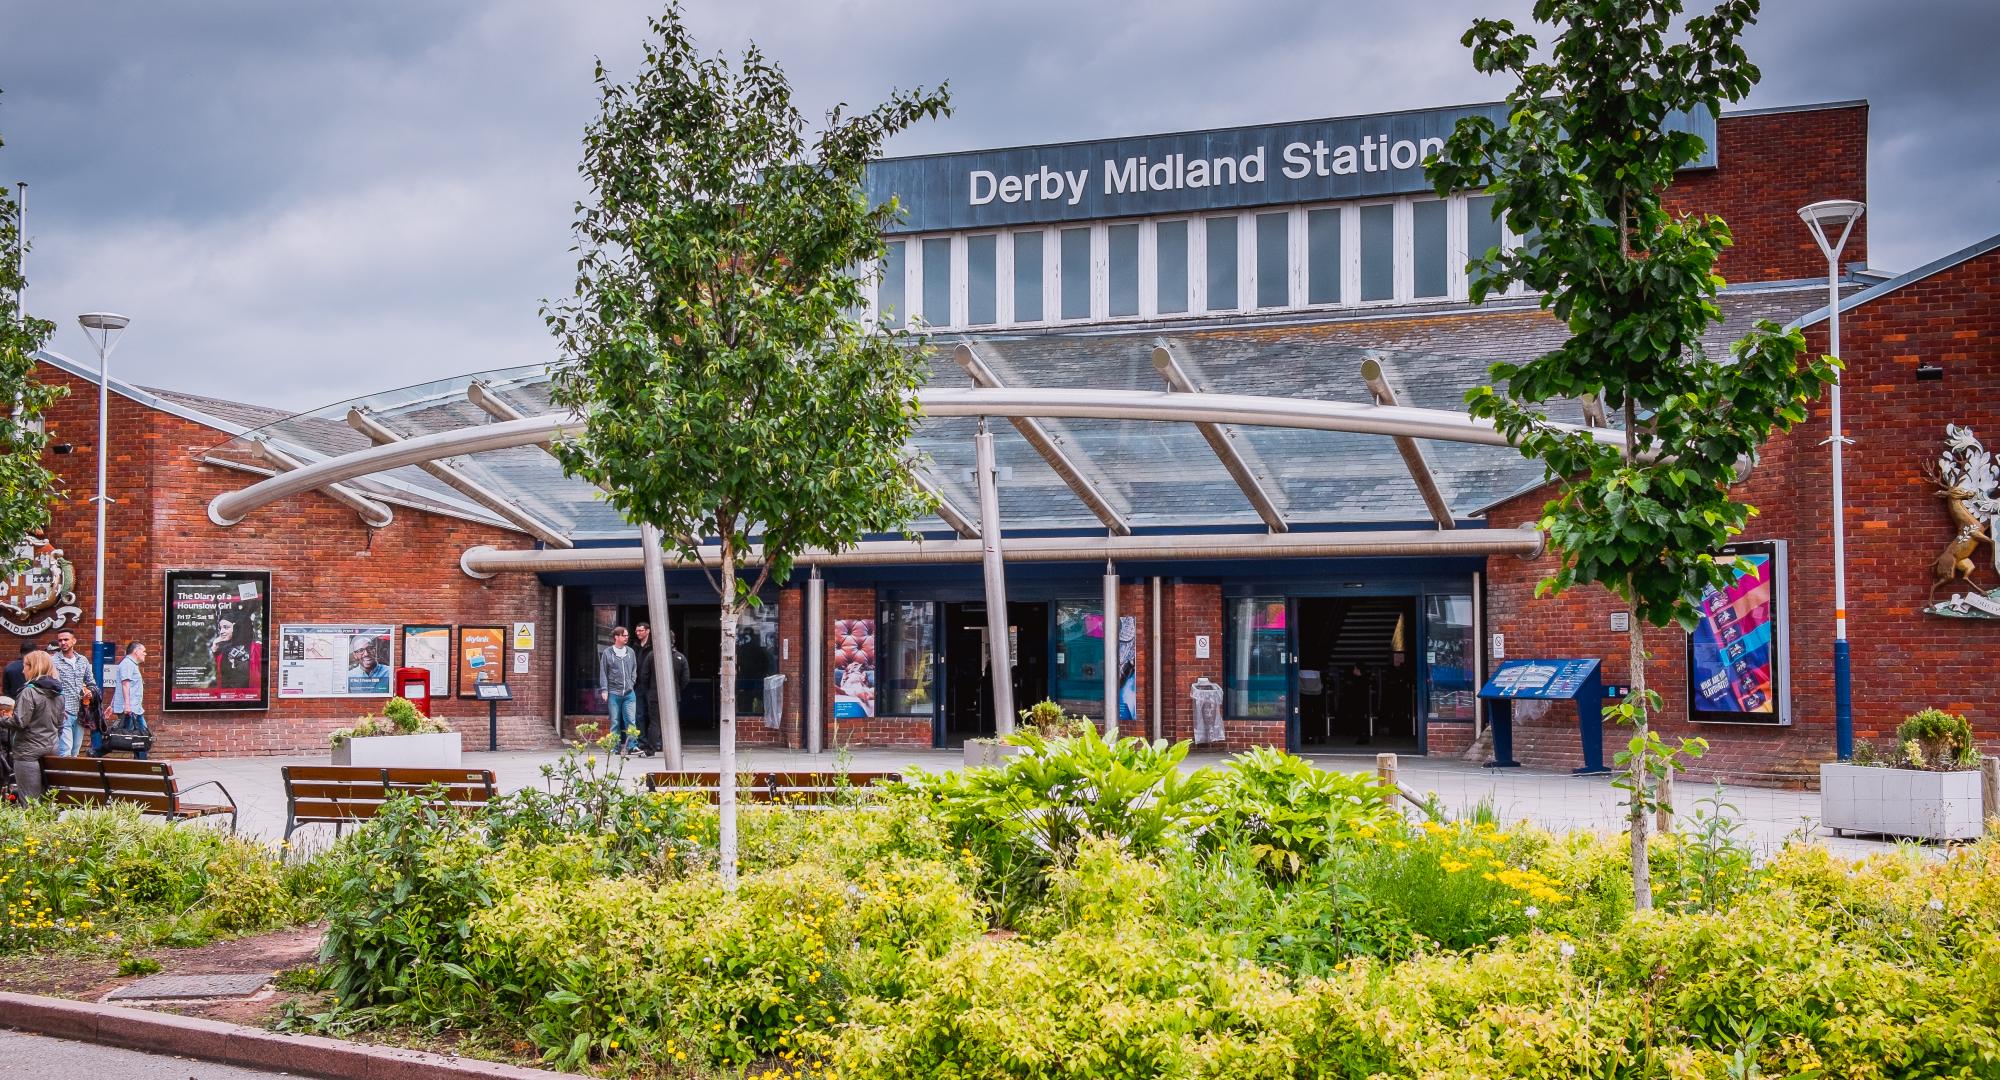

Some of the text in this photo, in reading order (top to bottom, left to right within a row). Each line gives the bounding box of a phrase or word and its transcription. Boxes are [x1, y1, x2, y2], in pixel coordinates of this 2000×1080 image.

[969, 134, 1445, 205] Derby Midland Station
[177, 592, 192, 600] The
[194, 592, 215, 601] Diary
[217, 592, 226, 600] of
[177, 602, 232, 610] Hounslow Girl
[3, 620, 47, 634] MIDLAND
